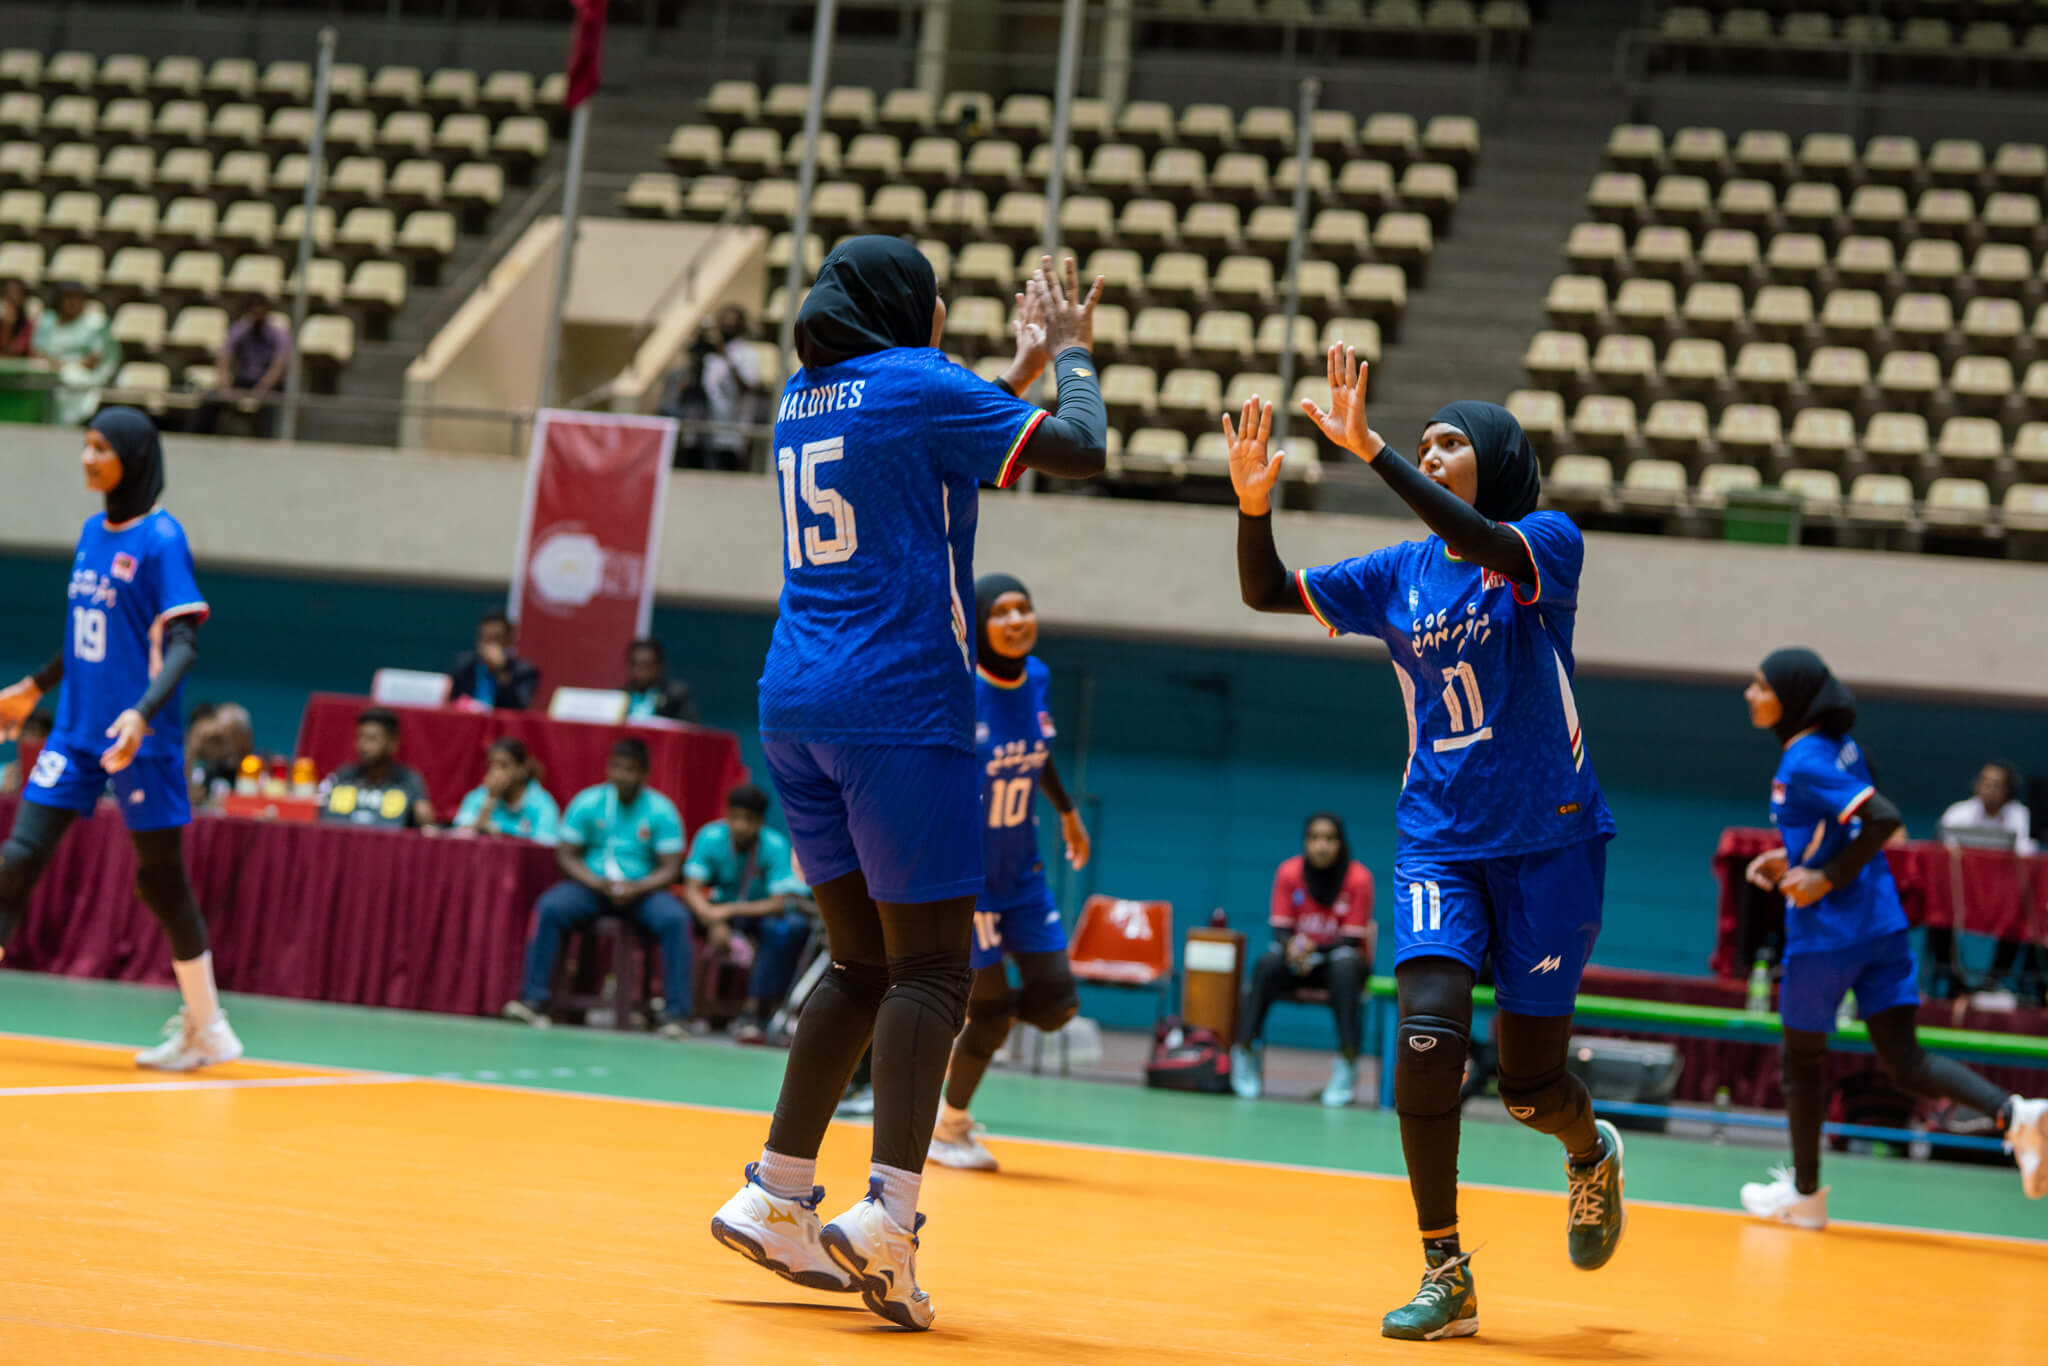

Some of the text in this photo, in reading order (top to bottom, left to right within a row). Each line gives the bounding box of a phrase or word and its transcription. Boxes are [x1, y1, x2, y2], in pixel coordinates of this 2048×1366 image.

[777, 380, 865, 424] MALDIVES
[778, 436, 858, 569] 15
[73, 606, 106, 663] 19
[988, 778, 1032, 828] 10
[1409, 880, 1441, 932] 11
